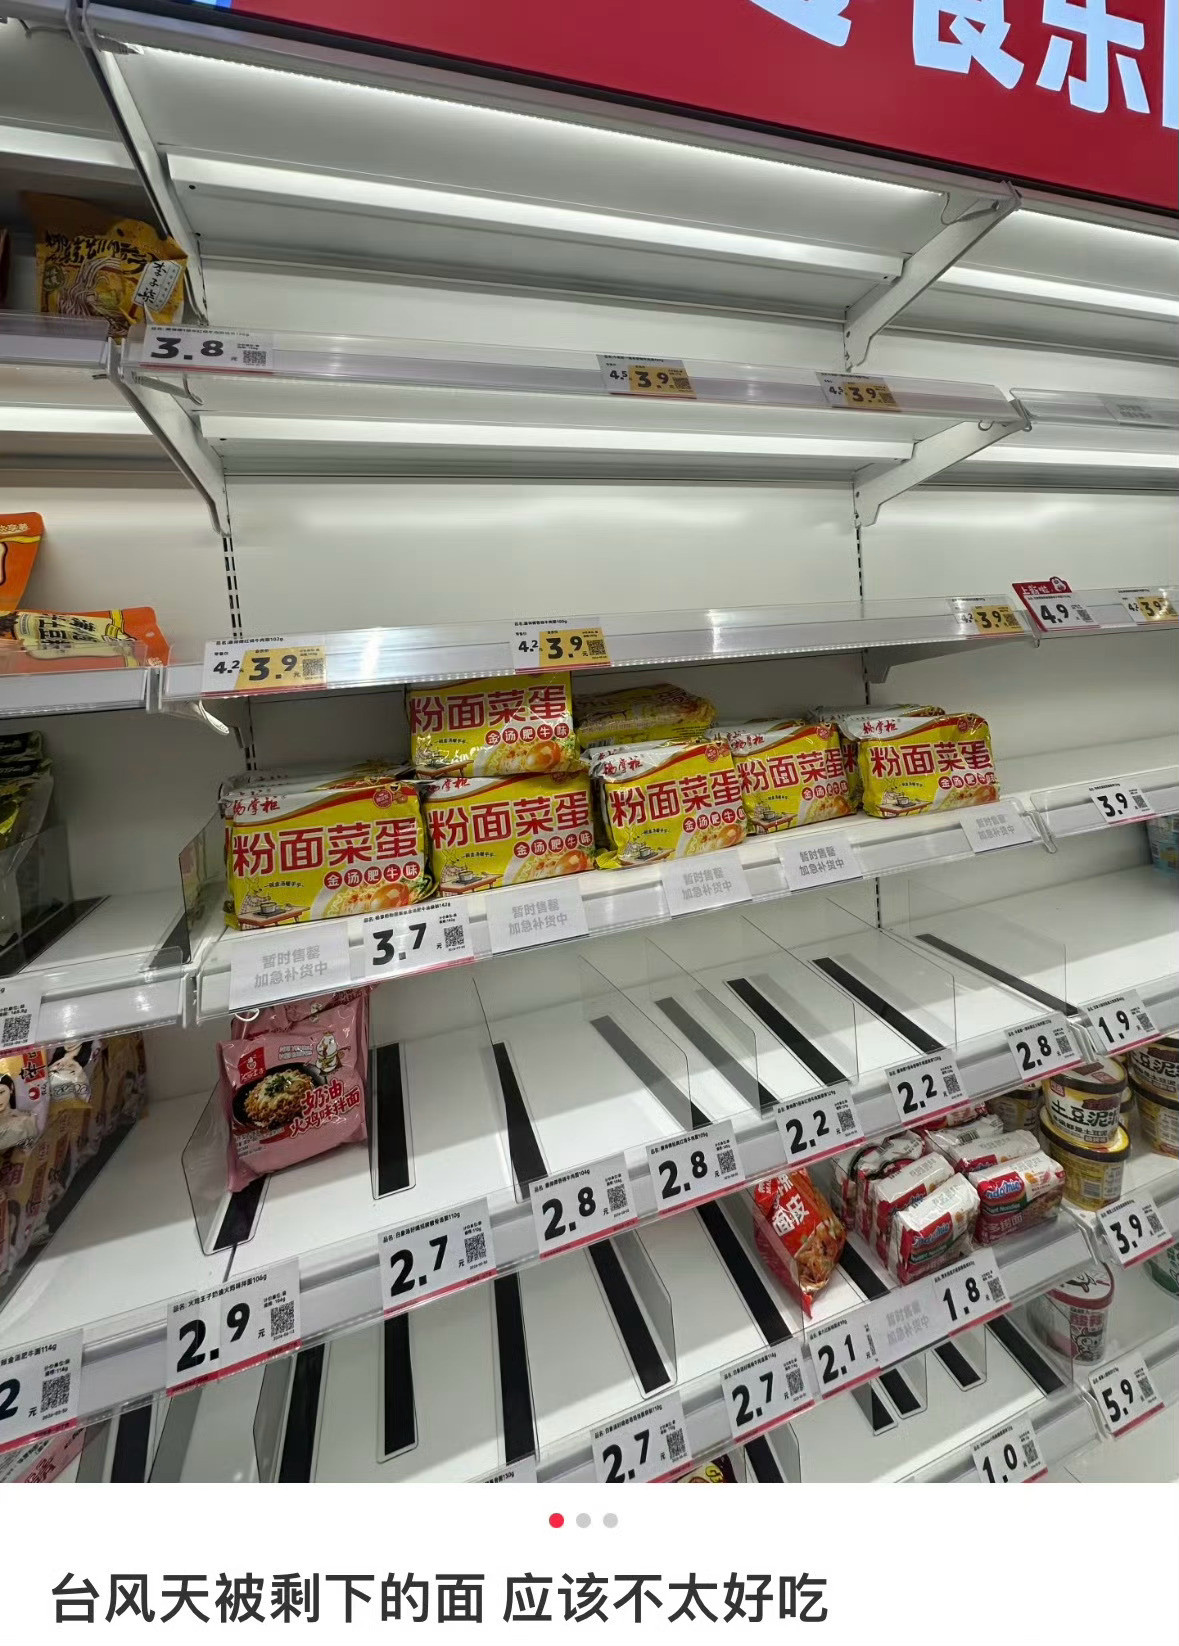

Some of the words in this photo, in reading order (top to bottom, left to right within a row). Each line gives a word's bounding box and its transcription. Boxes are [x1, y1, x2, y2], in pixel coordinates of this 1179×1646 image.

[150, 337, 225, 360] 3.8
[634, 370, 669, 389] 3.9
[851, 386, 878, 402] 3.9
[978, 610, 1003, 629] 3.9
[1040, 603, 1069, 624] 4.9
[518, 640, 538, 653] 4.2
[546, 635, 582, 659] 3.9
[213, 660, 240, 674] 4.2
[249, 655, 298, 681] 3.9
[411, 685, 567, 735] 粉面菜蛋
[487, 724, 569, 747] 金汤肥牛味
[737, 748, 845, 794] 粉面菜蛋
[870, 740, 993, 778] 粉面菜蛋
[609, 769, 741, 827] 粉面菜蛋
[1097, 792, 1128, 817] 3.9
[428, 790, 590, 850] 粉面菜蛋
[233, 816, 418, 877] 粉面菜蛋
[513, 830, 593, 859] 金汤肥牛味
[326, 862, 419, 889] 金汤肥牛味
[262, 944, 321, 969] 暂时售罄
[373, 922, 427, 966] 3.7
[255, 962, 328, 990] 加急补货中
[1098, 1010, 1130, 1043] 1.9
[1016, 1035, 1052, 1071] 2.8
[289, 1088, 361, 1137] 火鸡味拌面
[301, 1080, 343, 1115] 奶油
[897, 1073, 938, 1114] 2.2
[786, 1110, 829, 1155] 2.2
[658, 1150, 708, 1200] 2.8
[542, 1186, 596, 1241] 2.8
[1110, 1214, 1143, 1255] 3.9
[390, 1235, 448, 1297] 2.7
[458, 1259, 465, 1268] 元
[943, 1277, 980, 1322] 1.8
[177, 1302, 250, 1373] 2.9
[258, 1328, 266, 1339] 元
[818, 1333, 855, 1384] 2.1
[0, 1379, 20, 1420] 2
[28, 1406, 37, 1418] 元
[732, 1370, 773, 1428] 2.7
[1102, 1379, 1134, 1423] 5.9
[602, 1428, 650, 1483] 2.7
[982, 1443, 1018, 1483] 1.0
